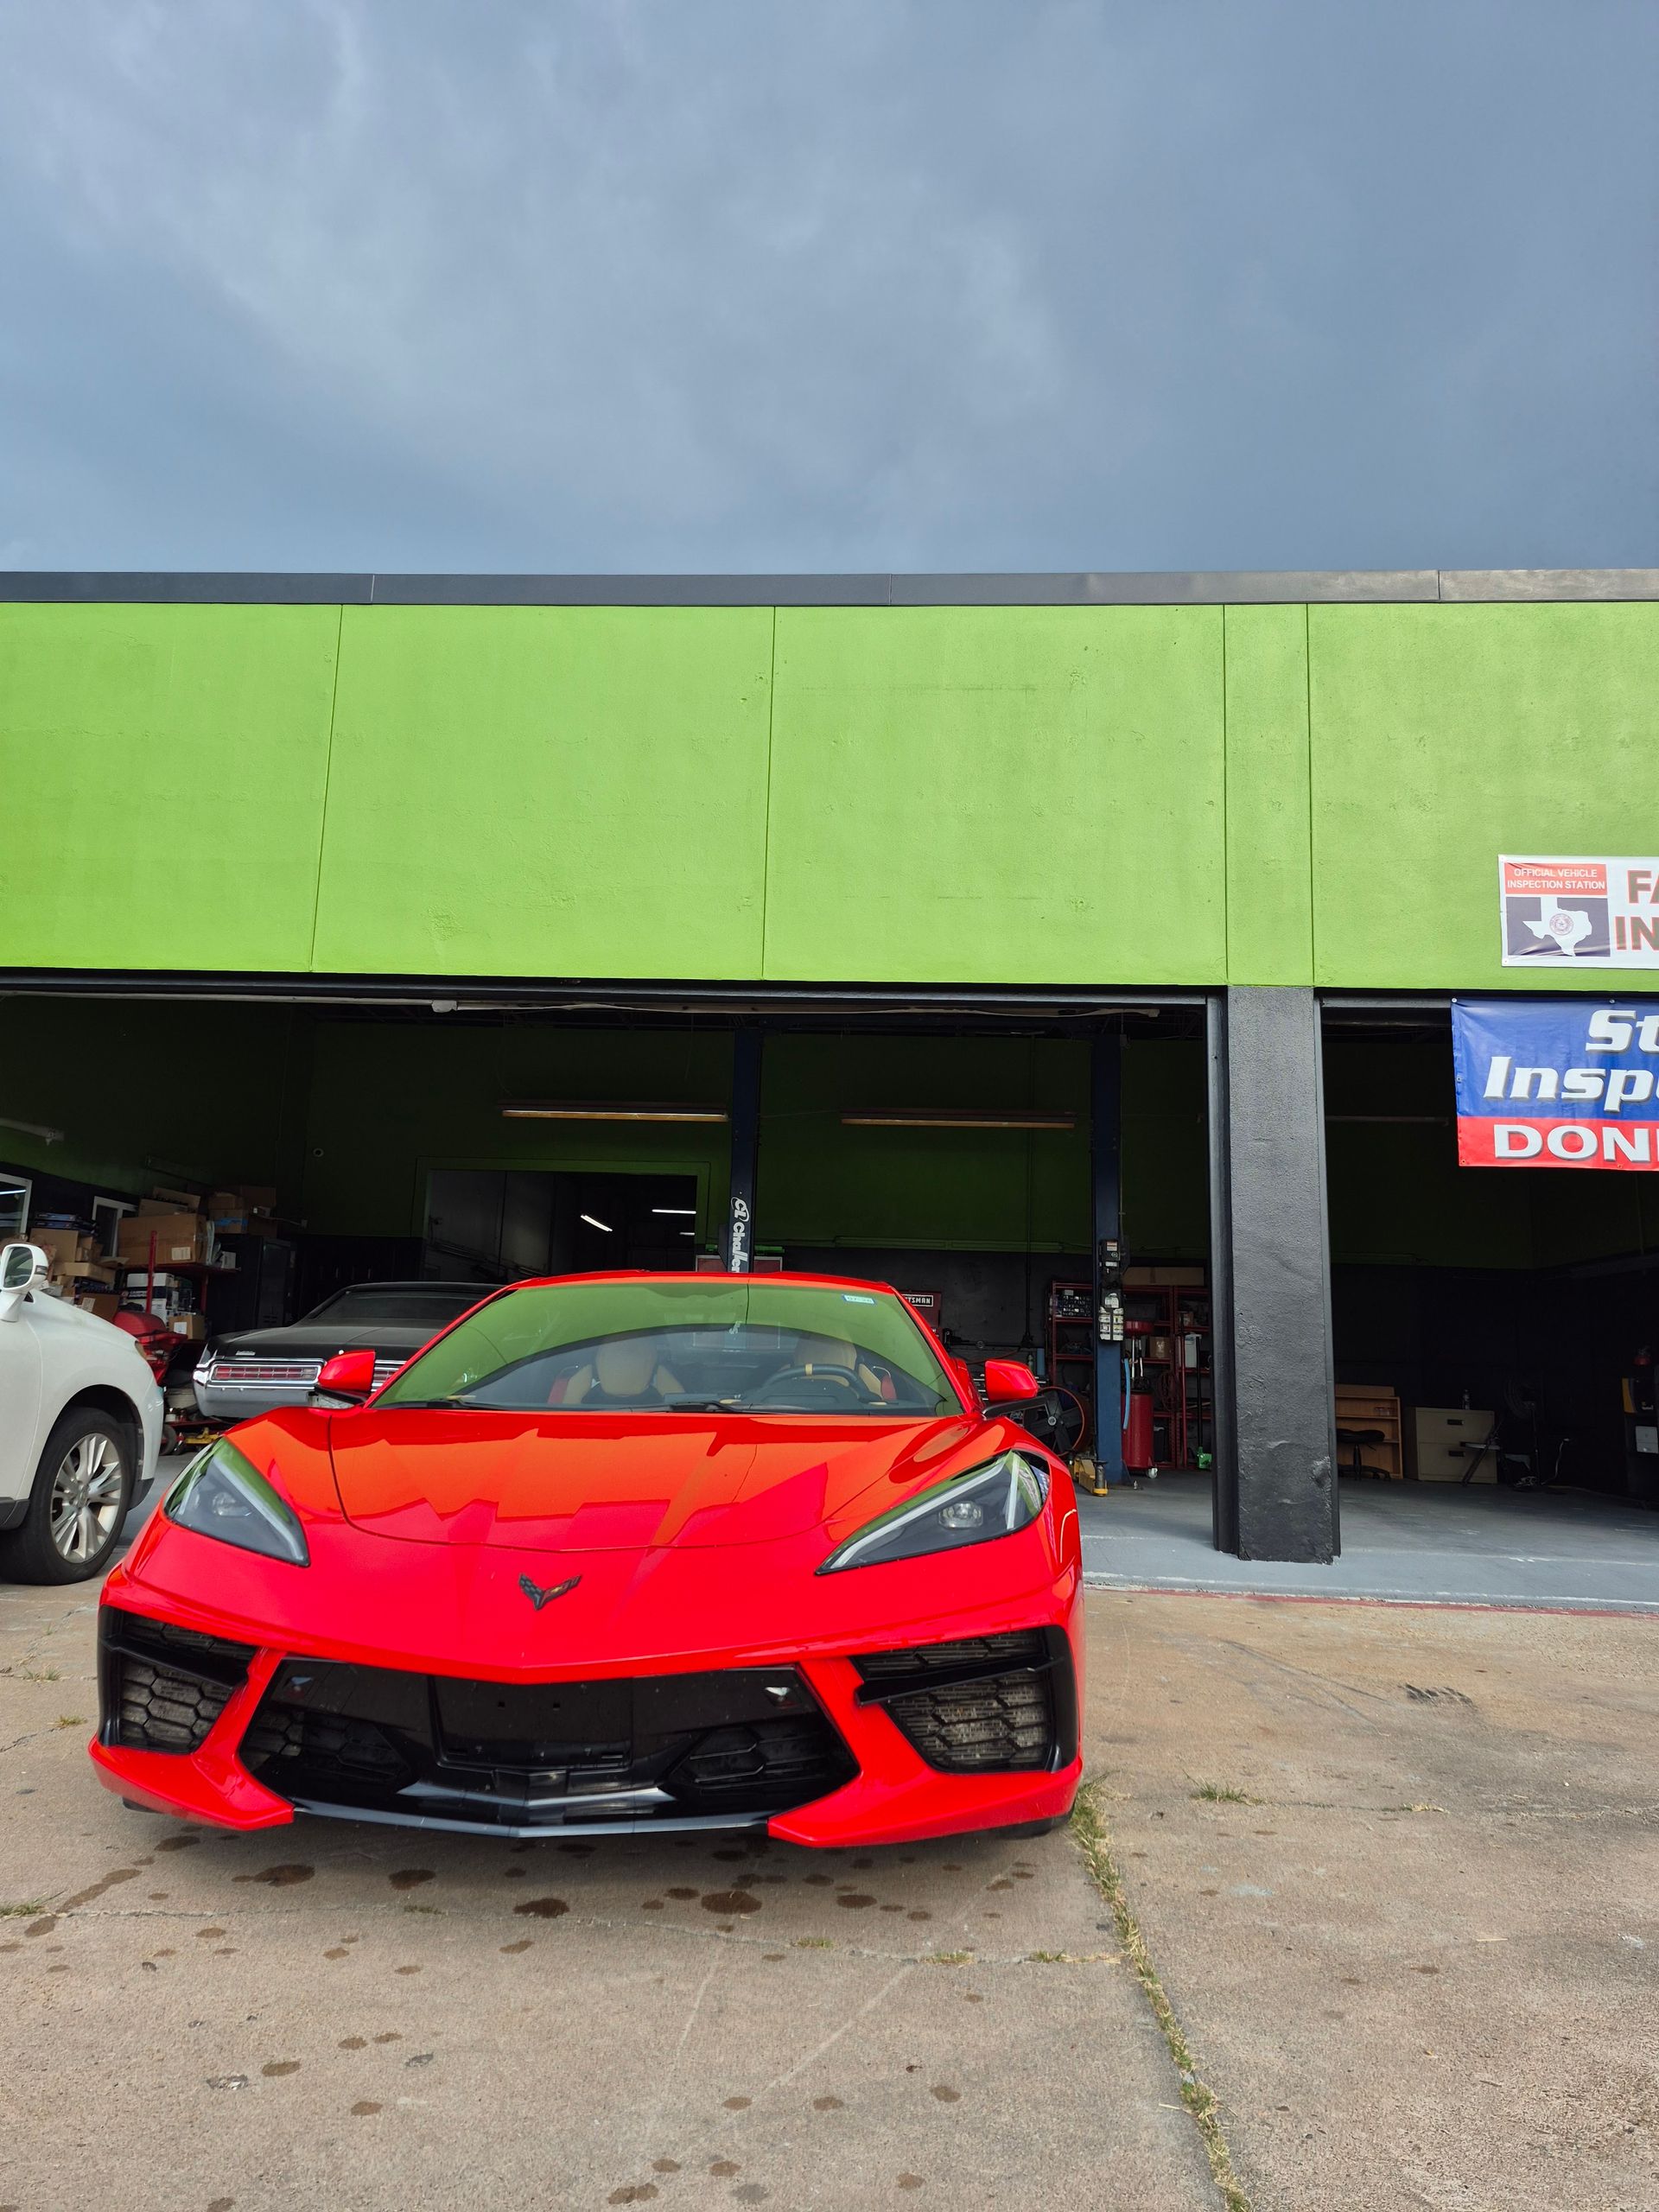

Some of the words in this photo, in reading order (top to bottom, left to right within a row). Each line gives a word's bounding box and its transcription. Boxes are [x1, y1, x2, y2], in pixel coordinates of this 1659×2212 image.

[1507, 880, 1563, 889] INSPECTION
[1514, 868, 1555, 877] OFFICIAL
[1558, 868, 1597, 878] VEHICLE
[1627, 870, 1659, 905] F
[1484, 1056, 1659, 1112] Insp
[1493, 1124, 1659, 1162] DON
